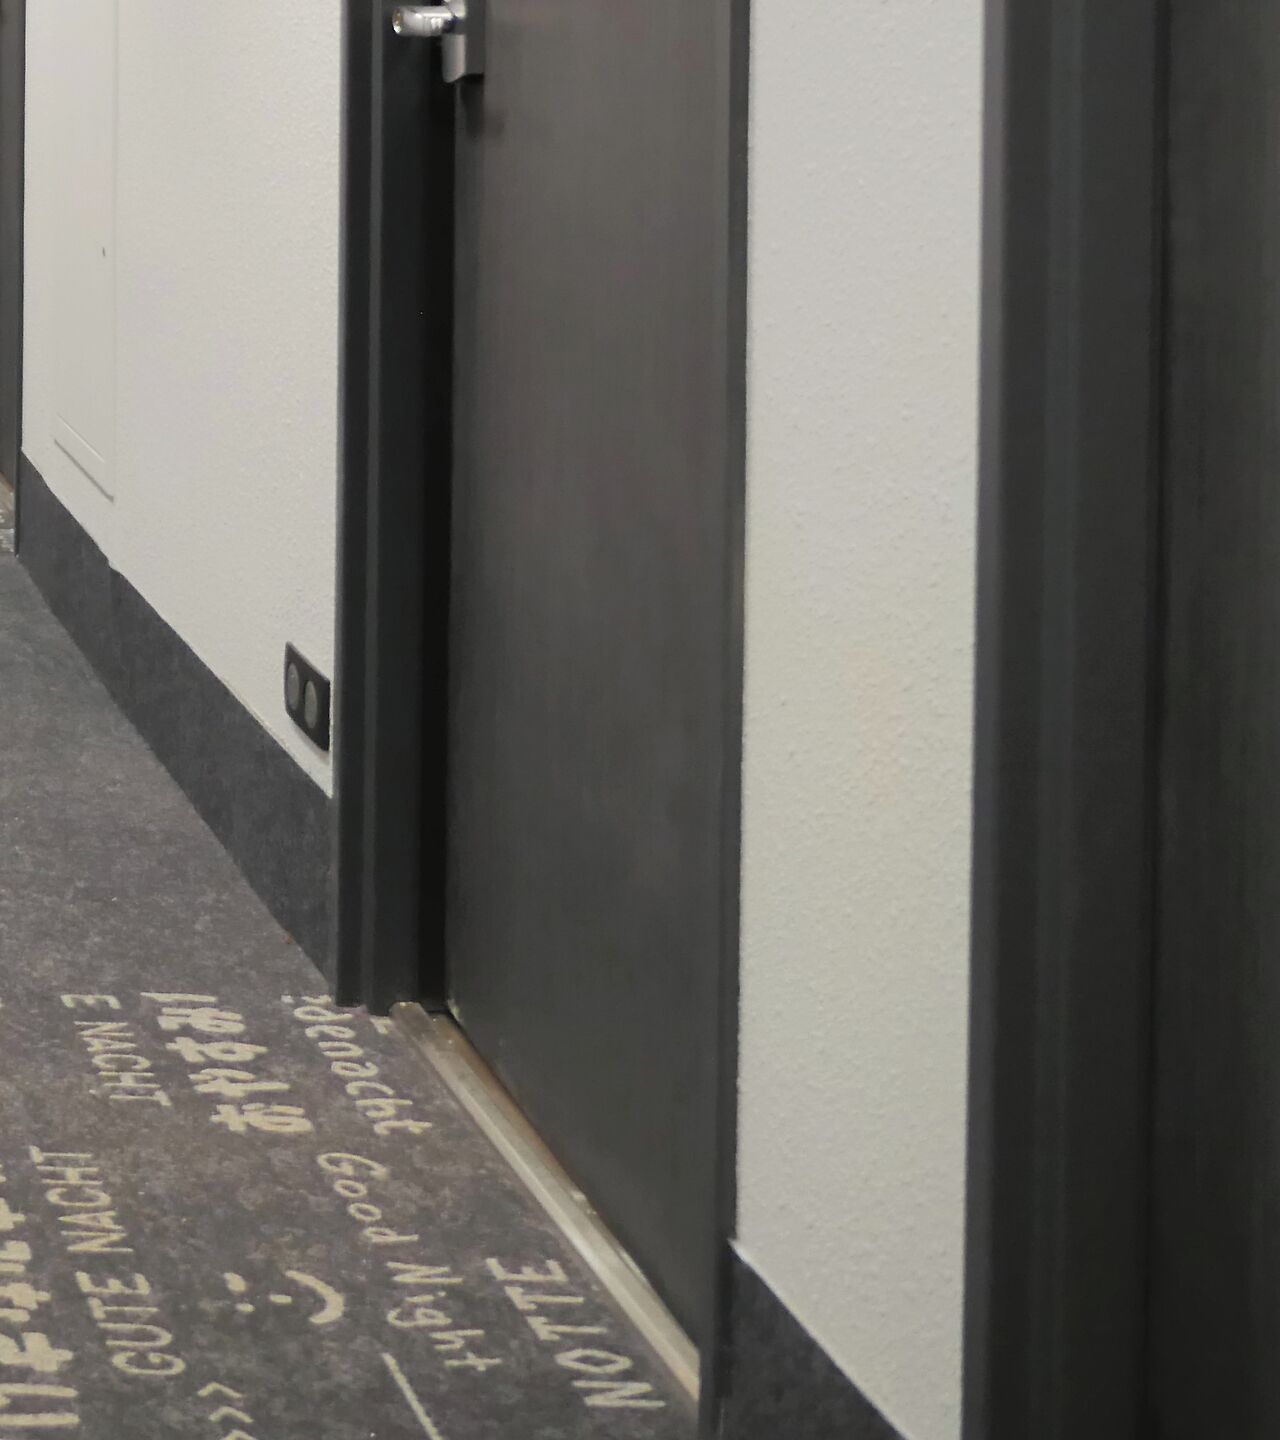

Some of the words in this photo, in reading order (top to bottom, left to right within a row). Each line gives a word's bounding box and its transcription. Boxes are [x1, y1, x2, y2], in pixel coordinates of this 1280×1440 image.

[72, 1019, 173, 1108] NACHT
[27, 1144, 136, 1256] NACHT
[316, 1151, 420, 1246] Good
[385, 1260, 503, 1373] Night
[73, 1269, 187, 1379] GUTE
[485, 1257, 667, 1411] NOTTE
